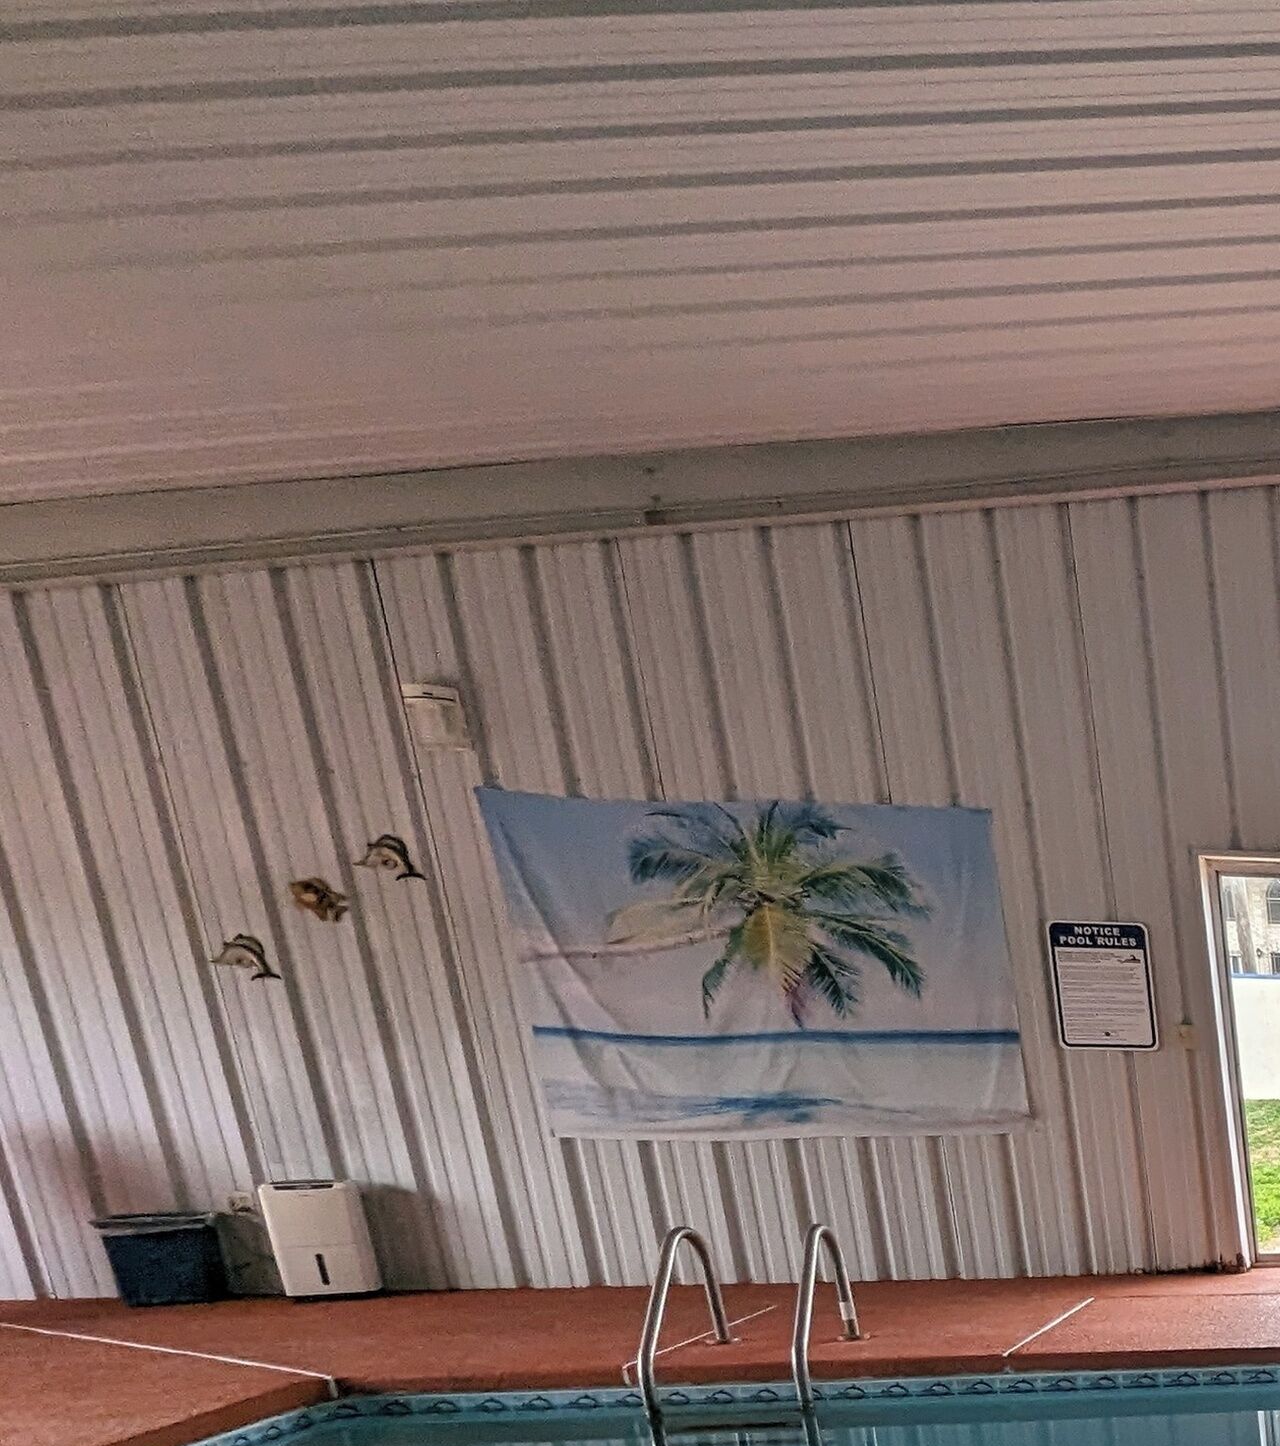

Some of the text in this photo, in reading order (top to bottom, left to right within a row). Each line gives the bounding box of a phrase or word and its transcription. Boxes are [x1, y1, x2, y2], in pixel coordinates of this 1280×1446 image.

[1073, 926, 1121, 936] NOTICE
[1059, 936, 1137, 947] POOL RULES
